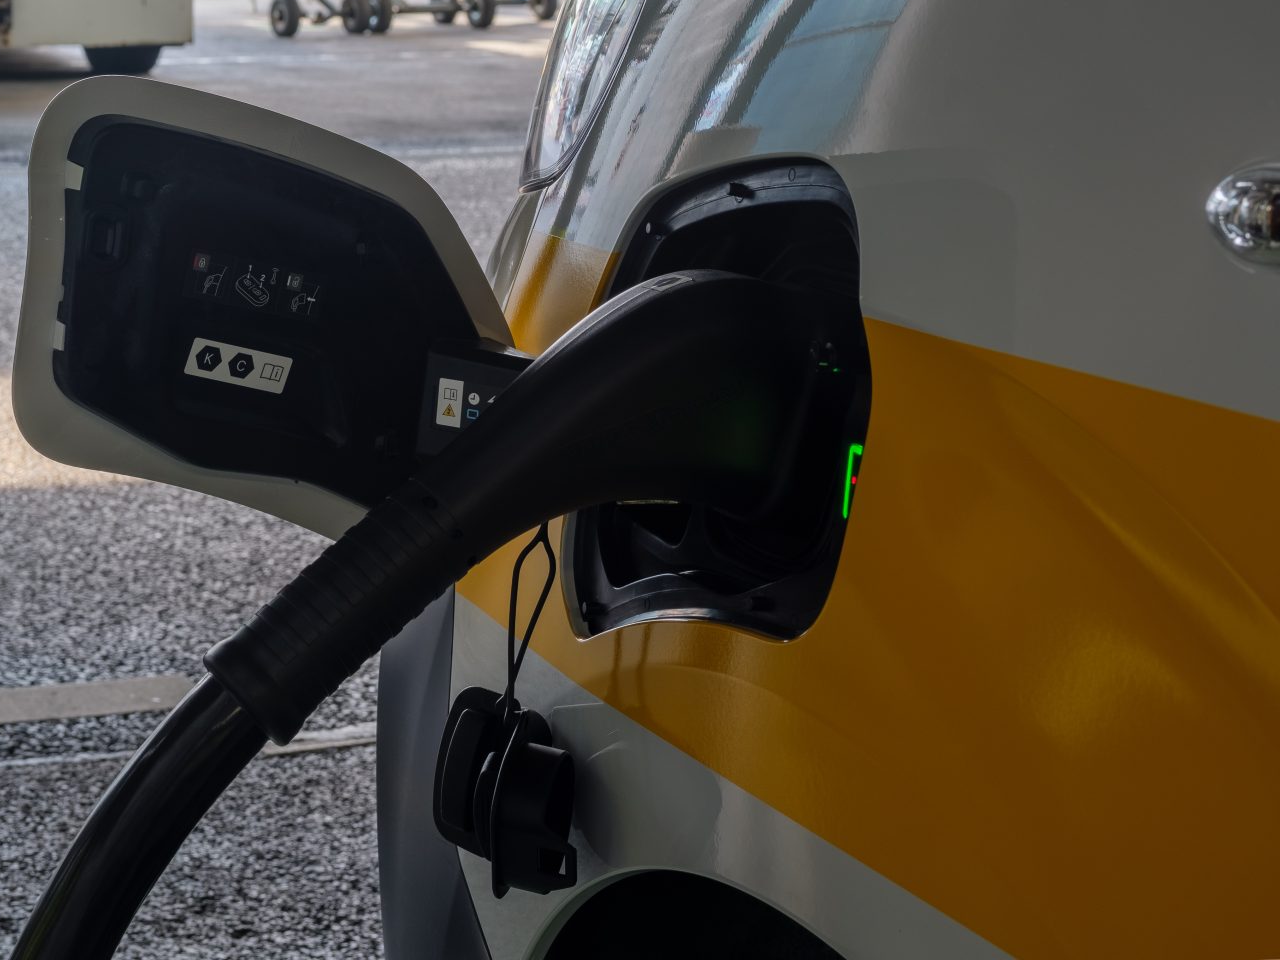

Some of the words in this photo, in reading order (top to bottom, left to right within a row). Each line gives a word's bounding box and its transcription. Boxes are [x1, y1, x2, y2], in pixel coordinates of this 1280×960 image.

[260, 274, 266, 282] 2
[203, 352, 215, 365] K
[236, 360, 247, 372] C
